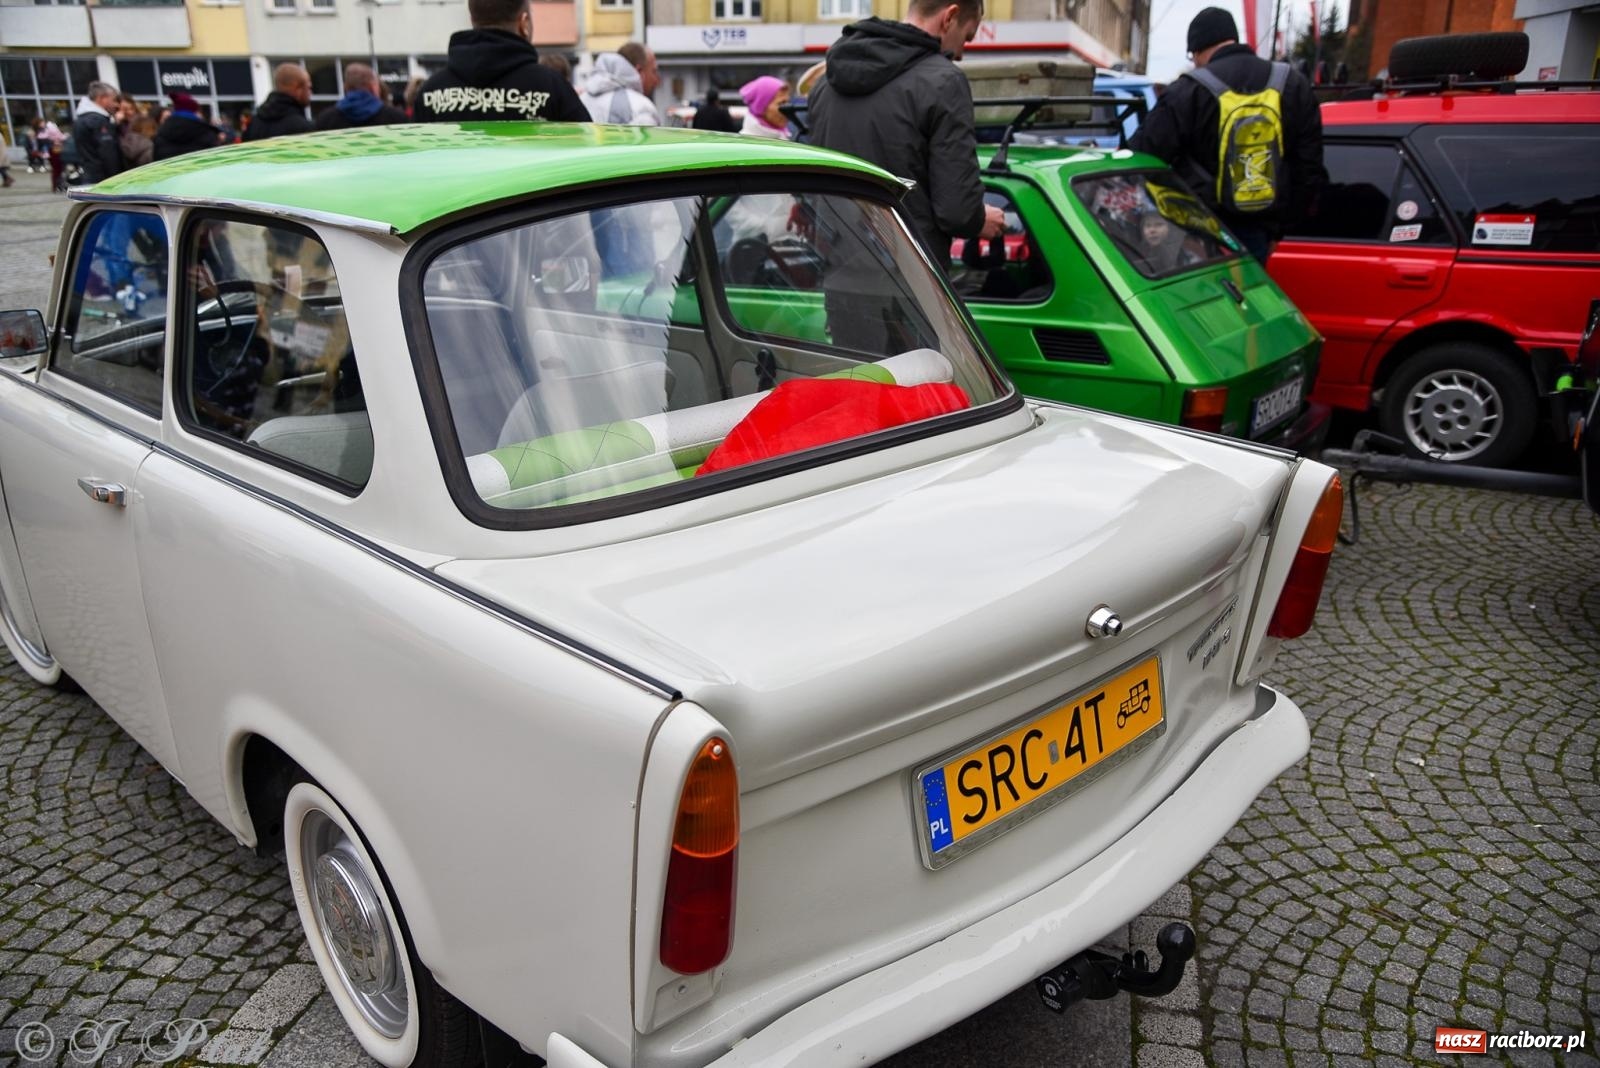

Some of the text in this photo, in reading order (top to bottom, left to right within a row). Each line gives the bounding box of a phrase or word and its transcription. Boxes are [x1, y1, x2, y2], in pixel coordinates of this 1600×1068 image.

[161, 66, 210, 90] empik
[423, 87, 550, 107] DIMENSION C-137
[957, 692, 1106, 824] SRC 4T
[930, 818, 949, 839] PL
